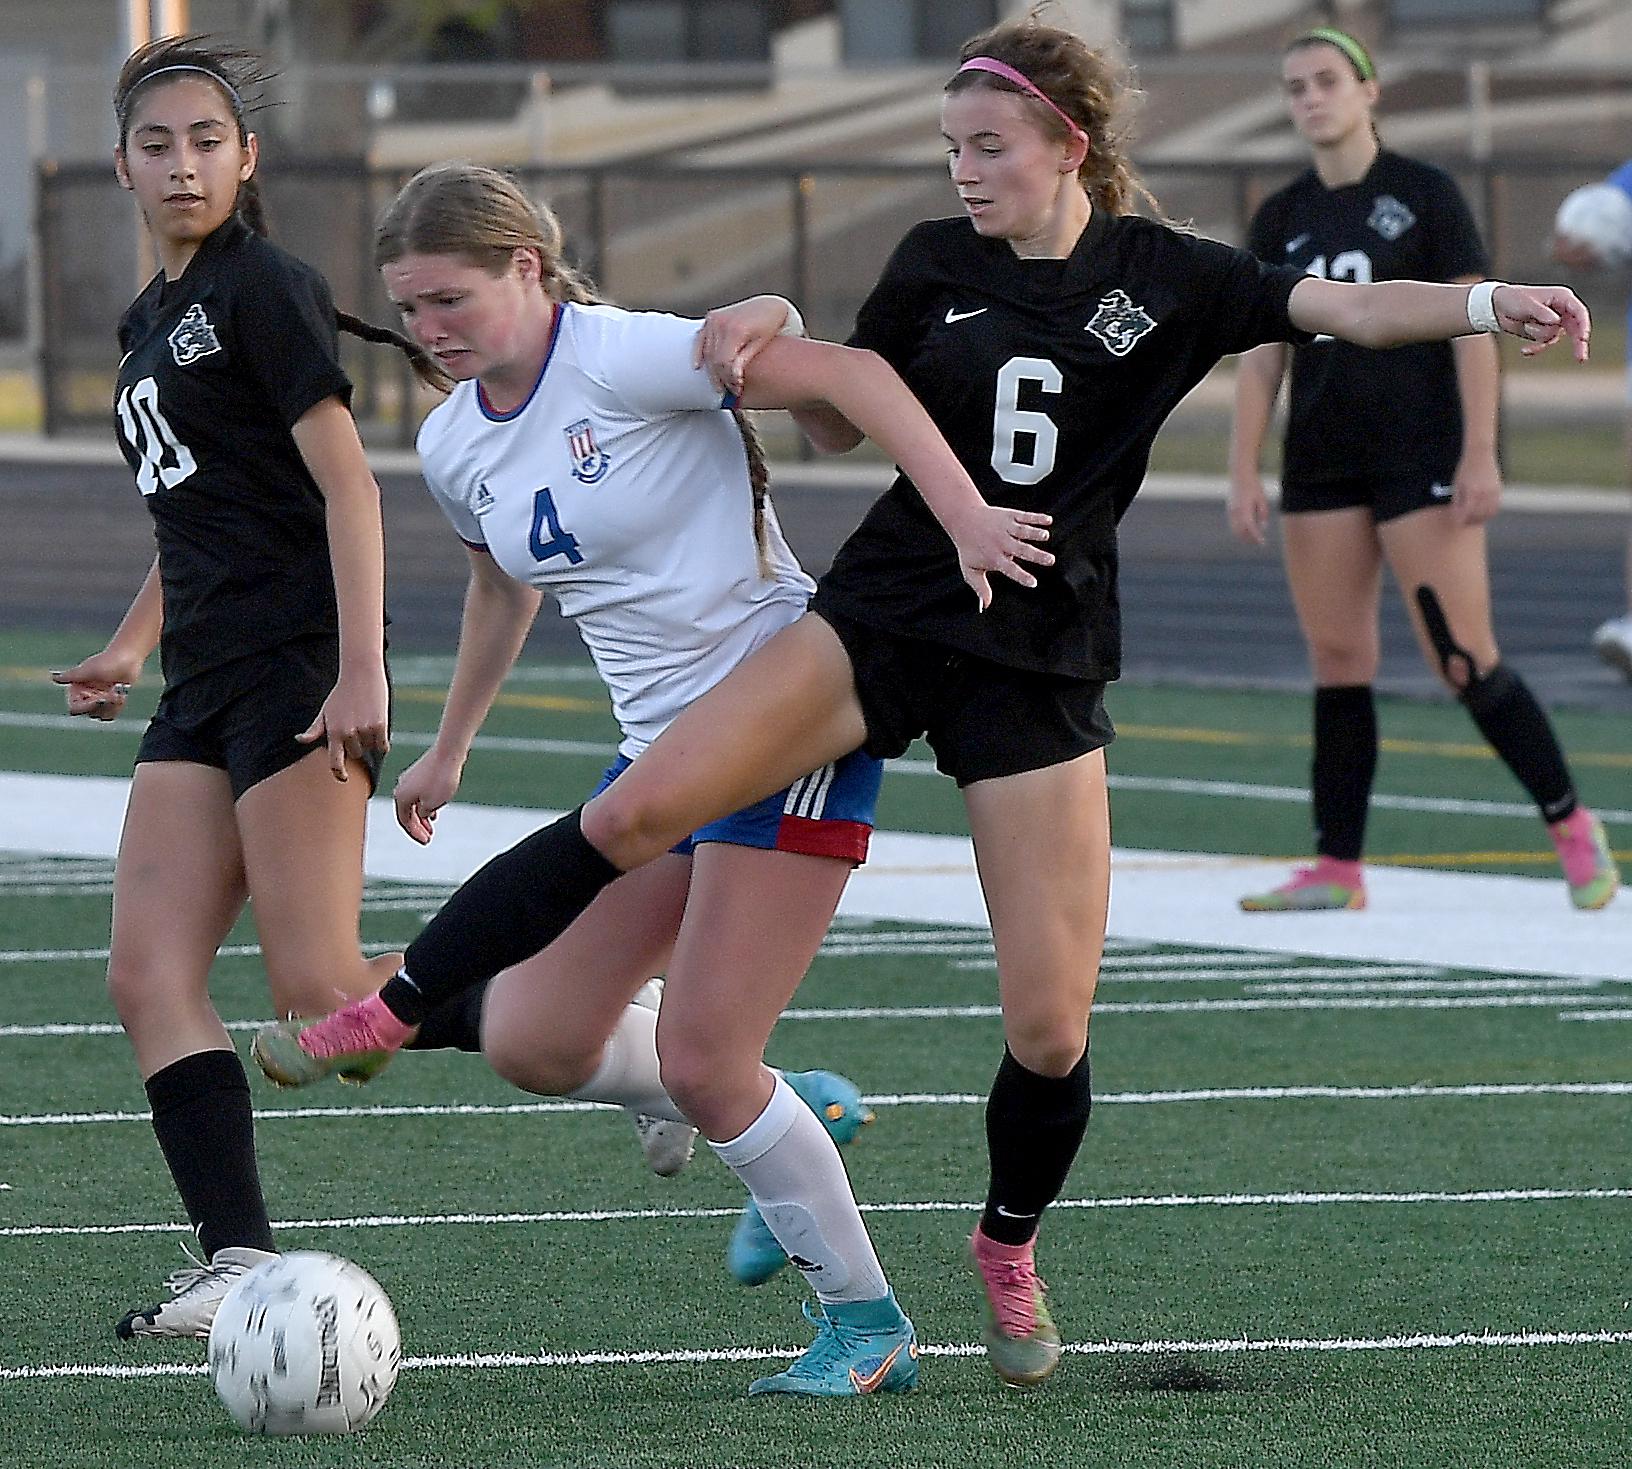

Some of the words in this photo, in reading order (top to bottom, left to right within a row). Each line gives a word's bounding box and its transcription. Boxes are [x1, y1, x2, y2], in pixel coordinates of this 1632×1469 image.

[116, 376, 198, 496] 10
[990, 356, 1063, 485] 6
[529, 486, 584, 565] 4
